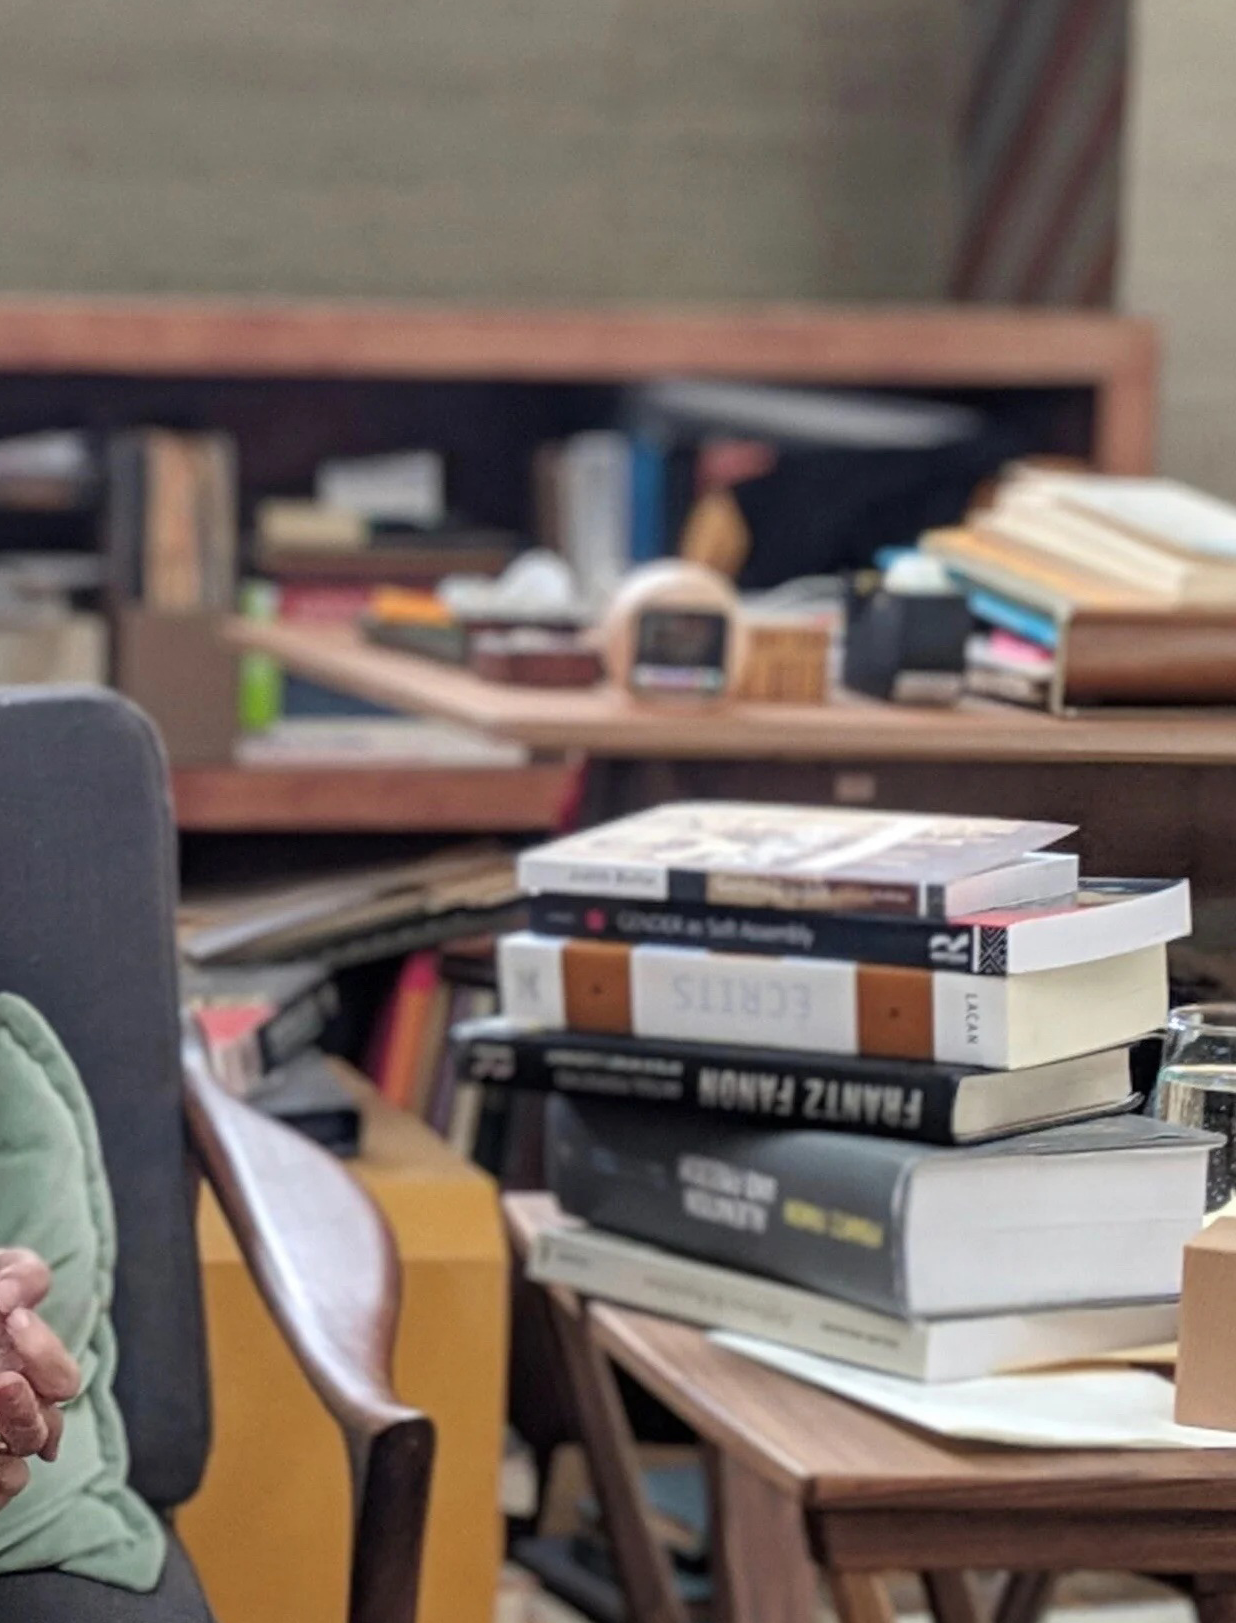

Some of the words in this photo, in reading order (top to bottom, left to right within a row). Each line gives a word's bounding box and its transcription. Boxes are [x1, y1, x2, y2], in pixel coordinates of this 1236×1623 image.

[929, 932, 969, 963] R
[965, 992, 980, 1046] LACAN
[698, 1066, 797, 1117] FANON
[802, 1077, 923, 1130] FRANTZ
